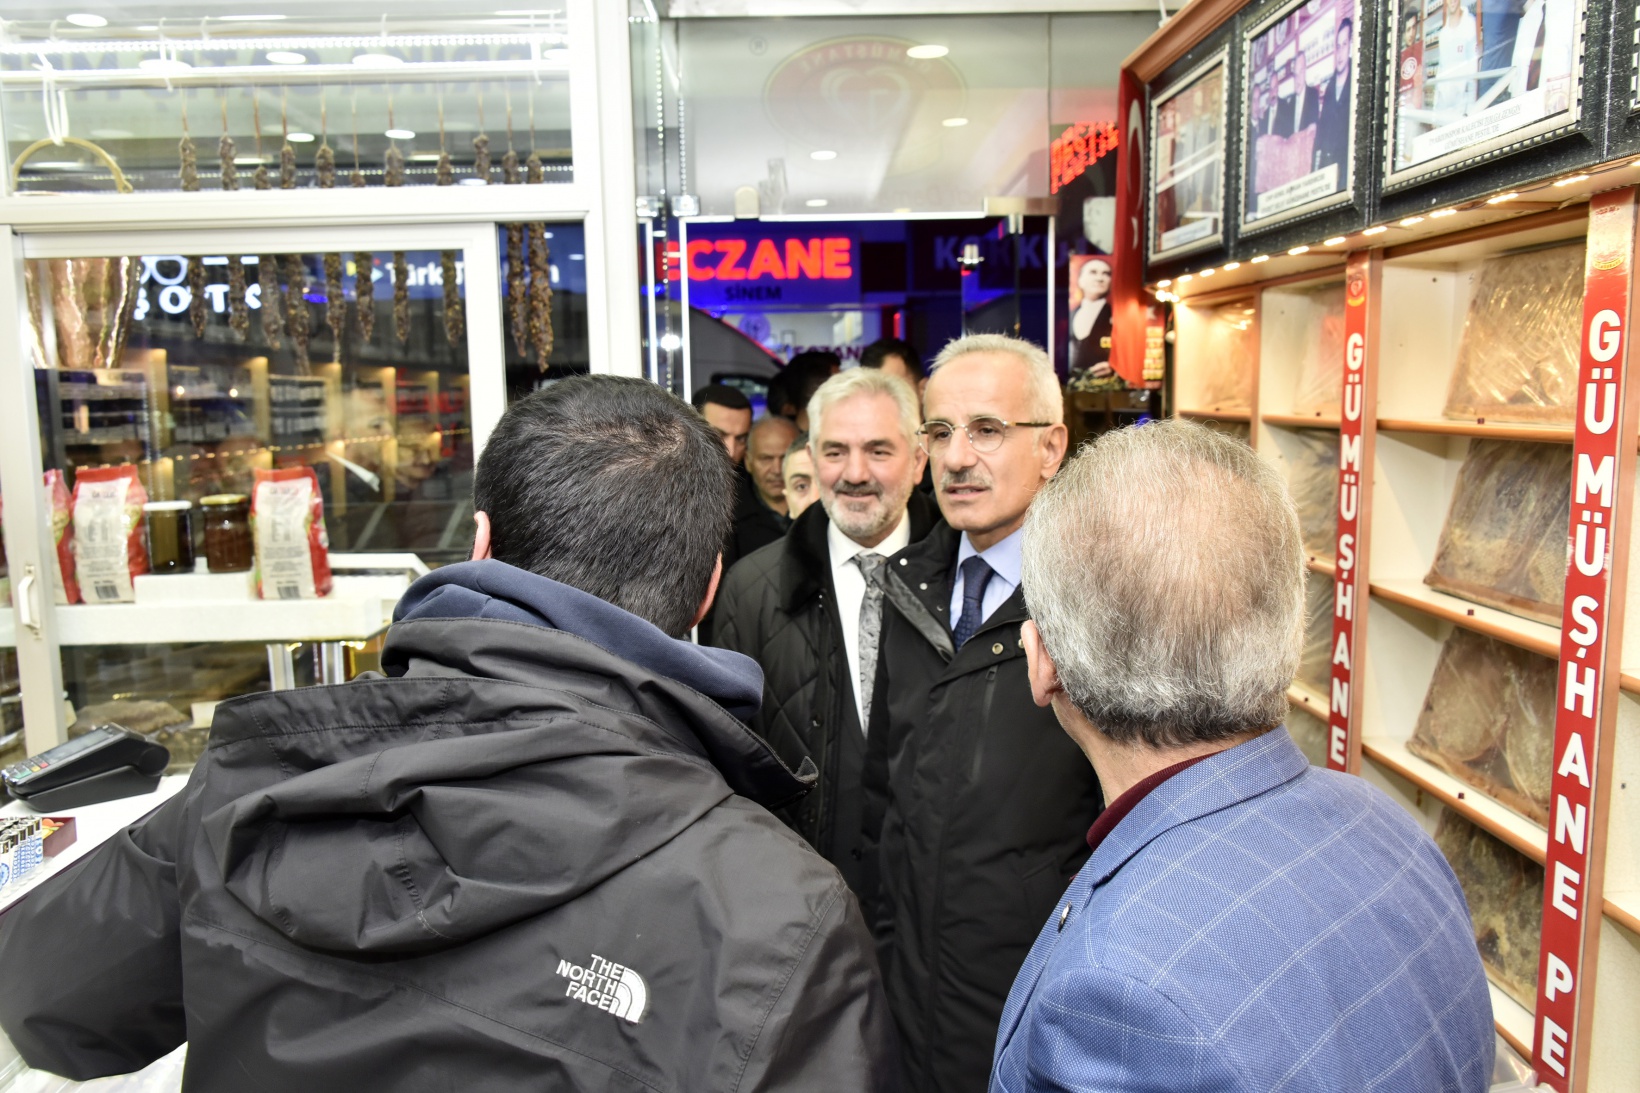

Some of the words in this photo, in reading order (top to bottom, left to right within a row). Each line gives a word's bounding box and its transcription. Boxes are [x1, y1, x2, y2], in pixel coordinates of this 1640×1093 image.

[656, 237, 852, 281] ECZANE
[1330, 332, 1363, 766] GÜMÜŞHANE
[1552, 309, 1621, 920] GÜMÜŞHANE
[555, 959, 618, 996] NORTH
[591, 953, 625, 981] THE
[565, 980, 612, 1011] FACE
